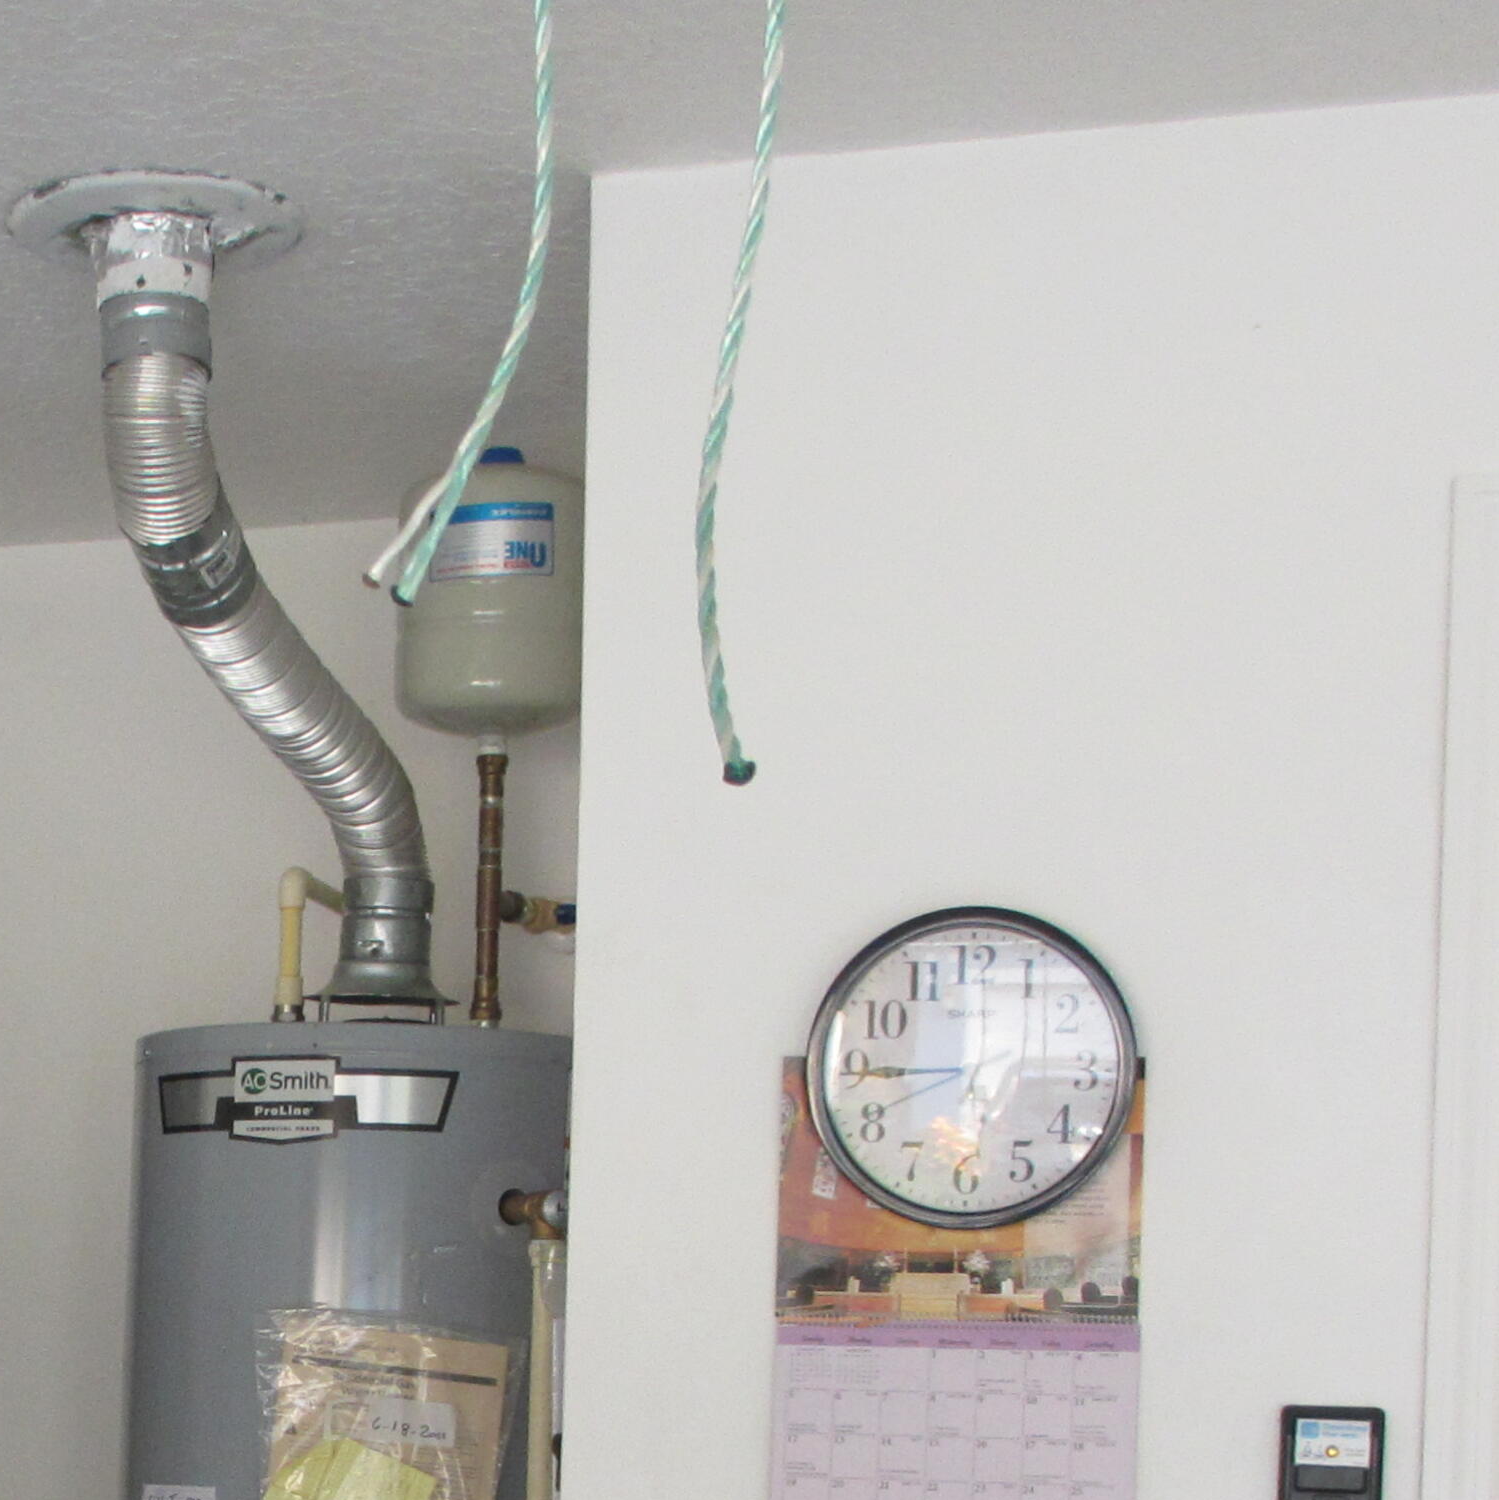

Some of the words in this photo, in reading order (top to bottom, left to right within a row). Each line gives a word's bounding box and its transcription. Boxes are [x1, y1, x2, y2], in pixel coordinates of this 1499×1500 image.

[905, 961, 940, 1001] 11
[953, 945, 997, 985] 12
[1019, 958, 1034, 999] 1
[864, 1000, 907, 1040] 10
[1054, 993, 1079, 1034] 2
[844, 1049, 869, 1089] 9
[1073, 1051, 1098, 1091] 3
[254, 1105, 311, 1117] ProLine
[860, 1103, 885, 1143] 8
[1047, 1104, 1073, 1144] 4
[900, 1141, 924, 1182] 7
[953, 1153, 981, 1194] 6
[1009, 1140, 1034, 1182] 5
